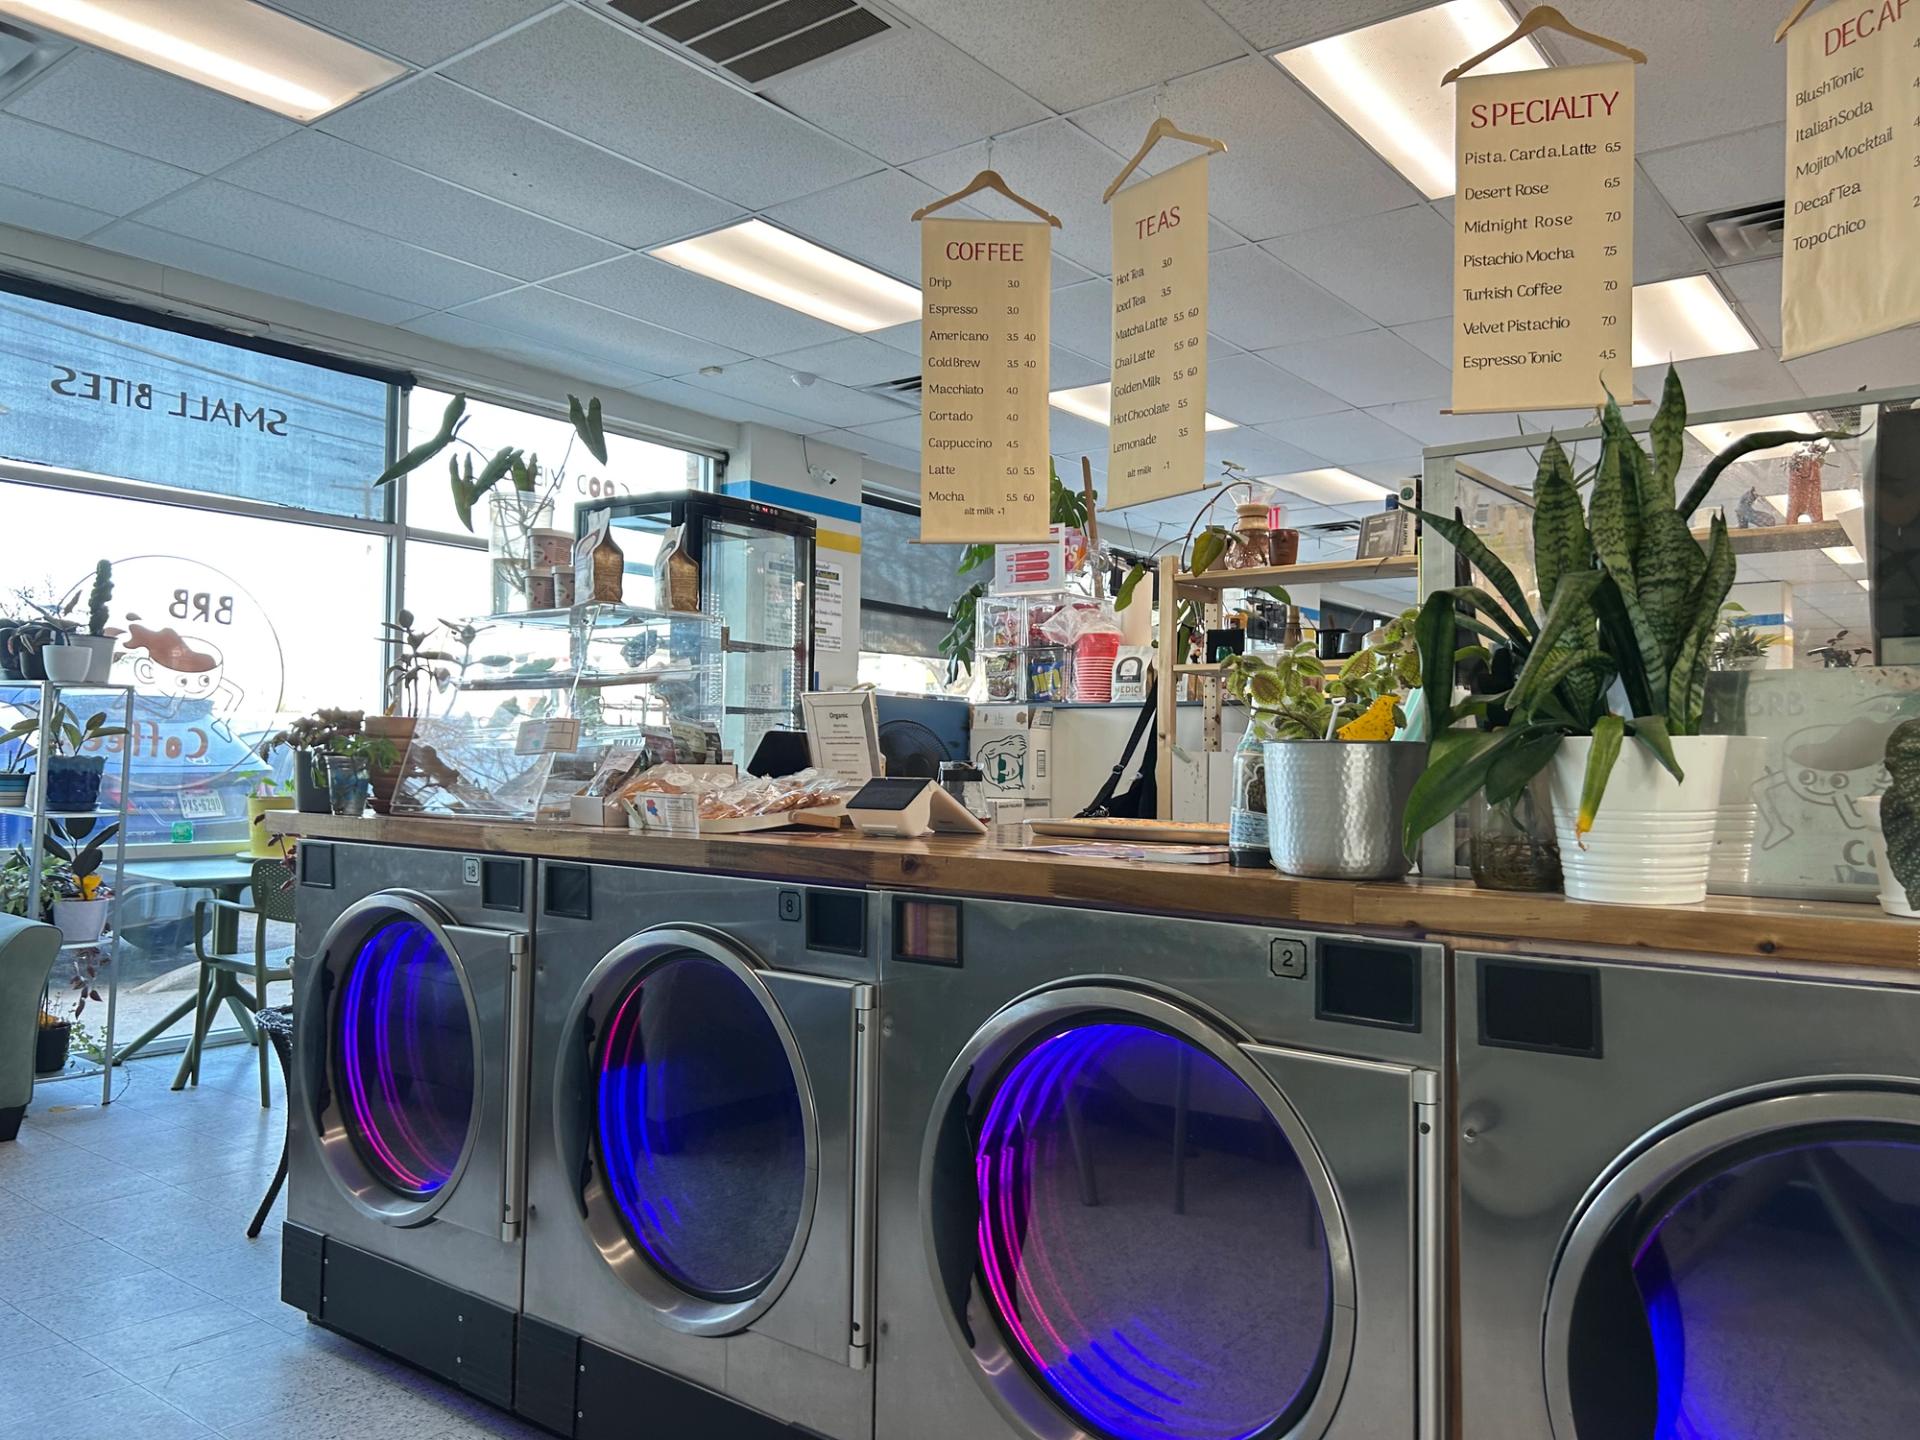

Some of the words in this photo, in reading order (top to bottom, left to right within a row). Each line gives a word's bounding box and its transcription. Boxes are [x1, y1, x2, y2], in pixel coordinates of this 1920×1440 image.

[1471, 91, 1619, 128] SPECIALTY
[1465, 187, 1511, 200] Desert
[1515, 184, 1549, 196] Rose
[1135, 206, 1180, 239] TEAS
[1464, 217, 1528, 234] Midnight
[1535, 214, 1573, 228] Rose
[946, 242, 1024, 261] COFFEE
[1463, 253, 1523, 267] Pistachio
[1526, 247, 1574, 262] Mocha
[929, 277, 952, 289] Drip
[1116, 273, 1129, 286] Hot
[1130, 267, 1145, 280] Tea
[1463, 288, 1513, 301] Turkish
[1516, 283, 1562, 298] Coffee
[929, 304, 978, 315] Espresso
[1116, 298, 1131, 313] Iced
[1131, 295, 1146, 308] Tea
[1463, 322, 1504, 335] Velvet
[1507, 316, 1571, 332] Pistachio
[929, 330, 989, 341] Americano
[1463, 355, 1527, 369] Espresso
[1528, 351, 1563, 364] Tonic
[928, 384, 984, 395] Macchiato
[928, 411, 973, 422] Cortado
[928, 438, 993, 450] Cappuccino
[1113, 434, 1157, 454] Lemonade
[928, 464, 956, 475] Latte
[928, 491, 965, 502] Mocha
[786, 899, 794, 913] 8
[1282, 950, 1294, 967] 2
